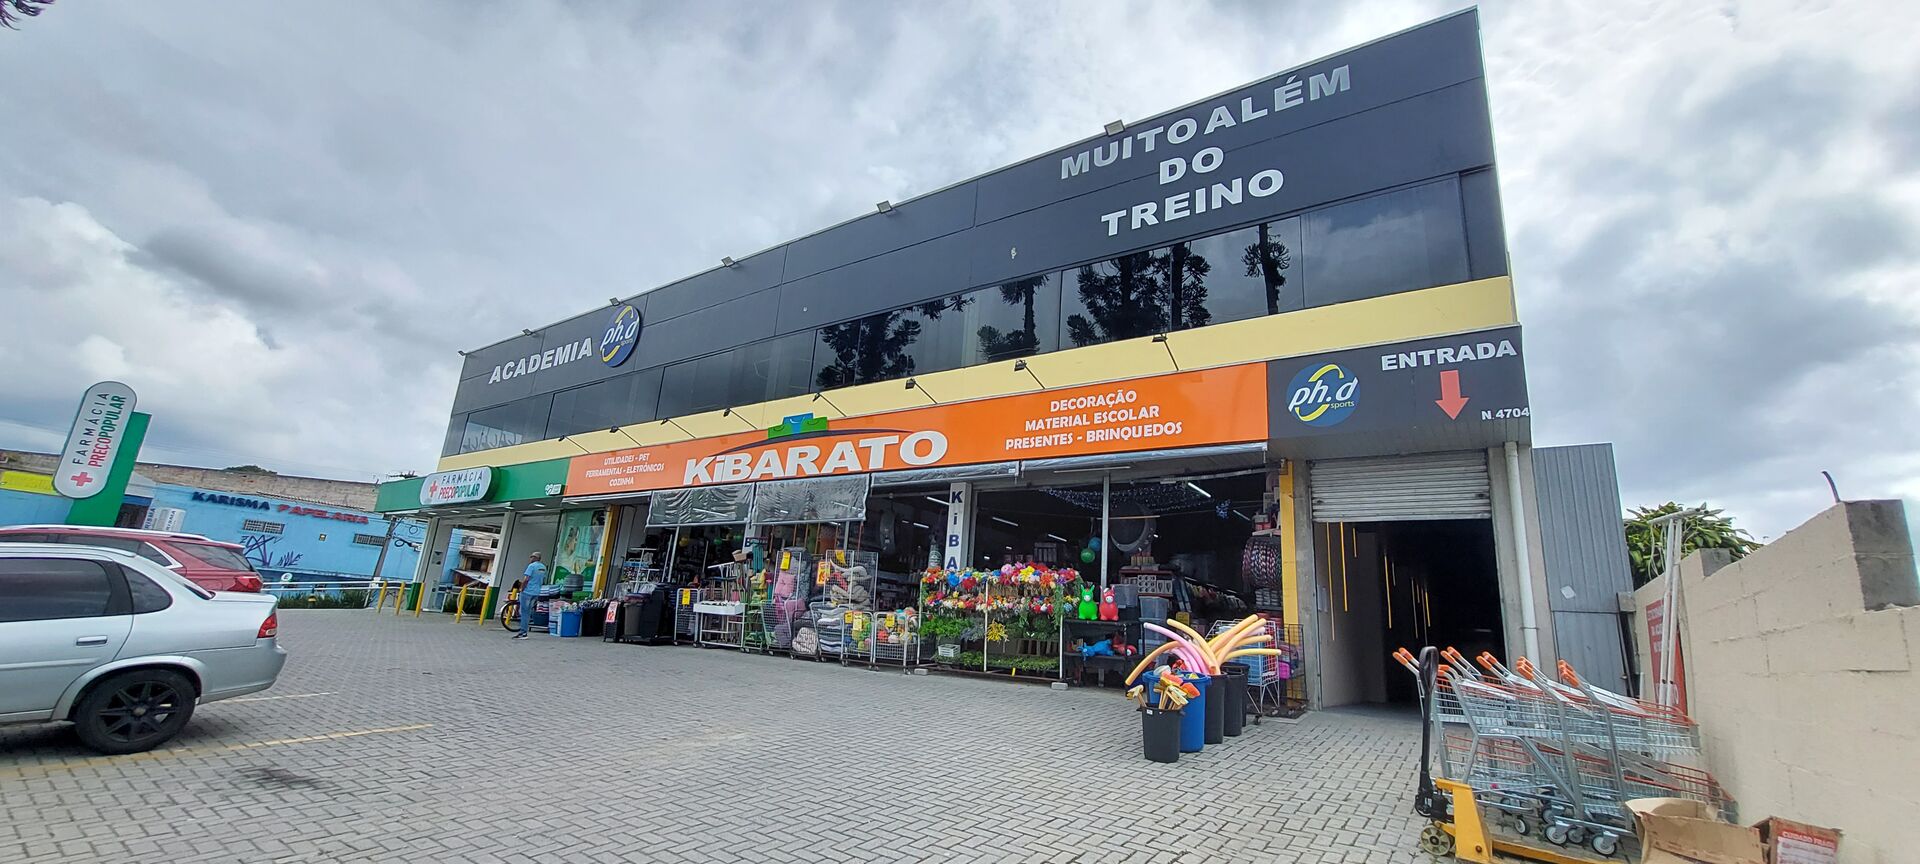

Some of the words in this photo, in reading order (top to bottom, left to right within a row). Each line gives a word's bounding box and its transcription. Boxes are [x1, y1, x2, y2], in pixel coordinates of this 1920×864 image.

[1159, 147, 1225, 185] DO
[1101, 169, 1284, 237] TREINO
[488, 337, 593, 385] ACADEMIA
[1381, 339, 1517, 371] ENTRADA
[1050, 389, 1137, 413] DECORAÇÃO
[1288, 377, 1359, 413] ph.d
[1330, 400, 1355, 410] sports
[72, 393, 110, 465] FARMÁCIA
[1025, 414, 1090, 432] MATERIAL
[1093, 405, 1160, 424] ESCOLAR
[1005, 432, 1073, 450] PRESENTES
[1086, 421, 1182, 443] BRINQUEDOS
[585, 467, 623, 478] FERRAMENTAS
[603, 454, 635, 466] UTILIDADES
[638, 453, 650, 462] PET
[609, 476, 634, 487] COZINHA
[191, 491, 271, 511] KARISMA
[277, 504, 369, 524] PAPELARIA
